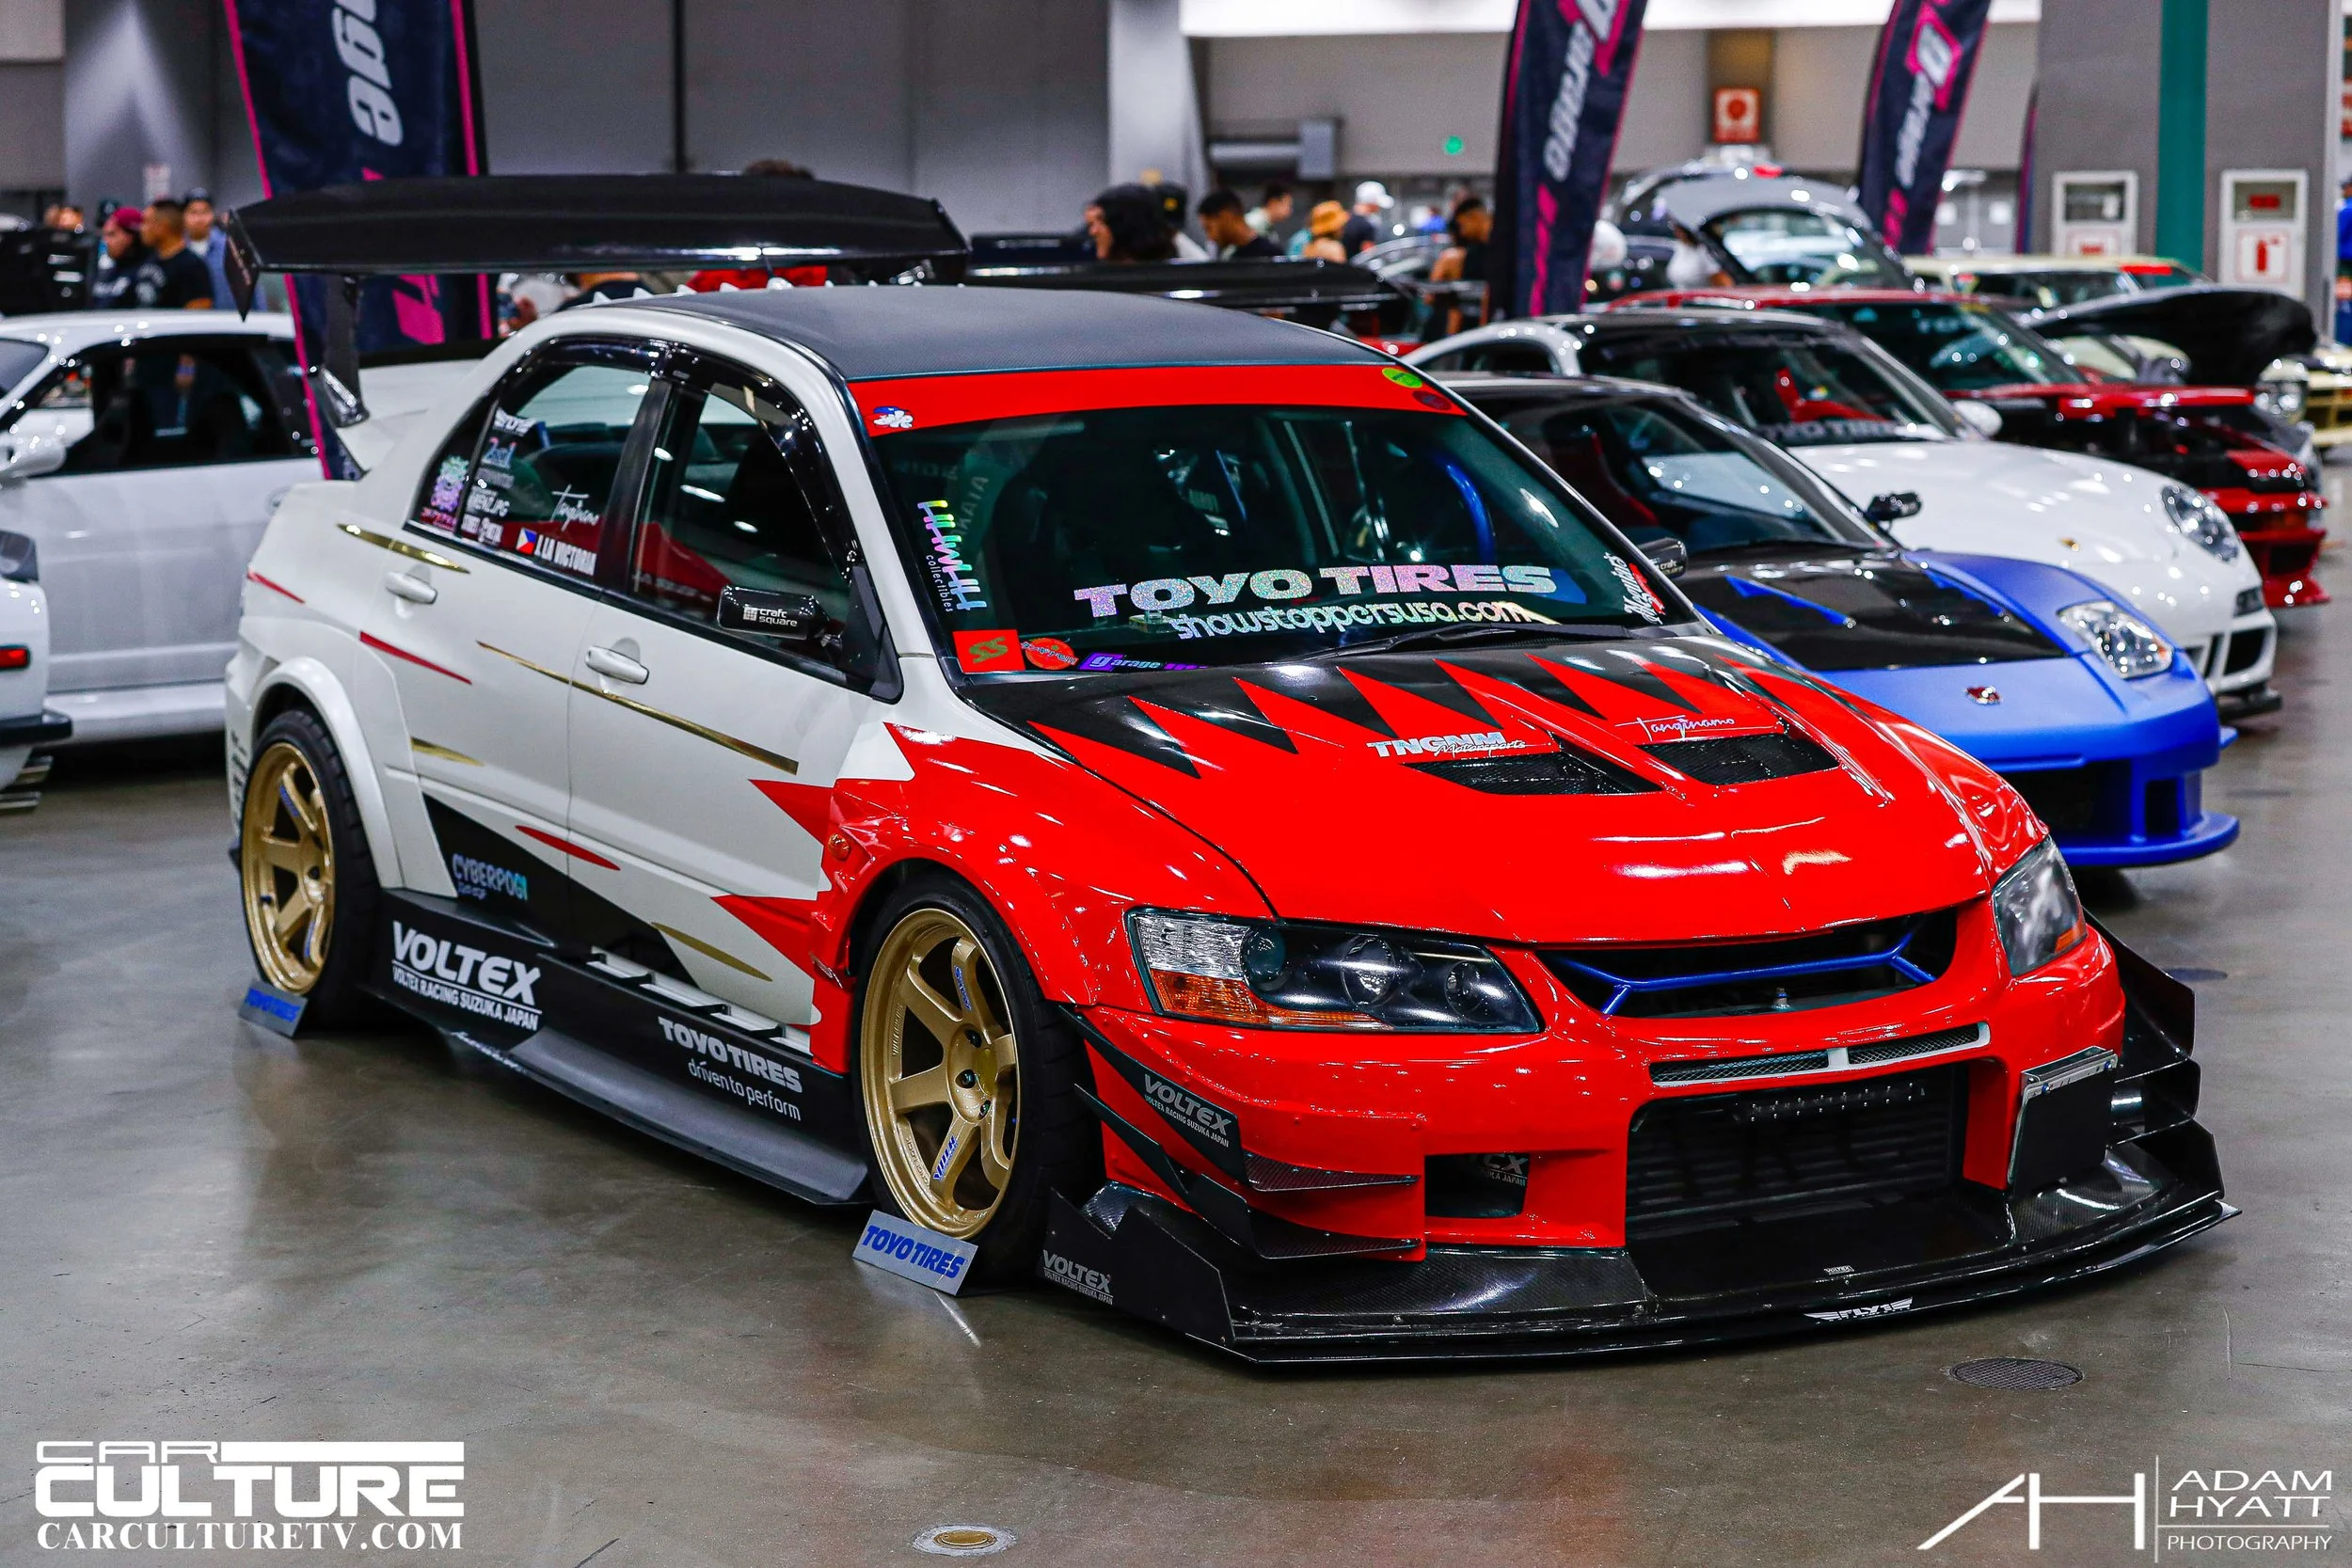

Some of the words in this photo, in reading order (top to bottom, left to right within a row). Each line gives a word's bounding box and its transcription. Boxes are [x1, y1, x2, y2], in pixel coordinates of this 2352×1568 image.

[925, 553, 954, 613] collectibles
[1073, 568, 1313, 618] TOYO
[1319, 564, 1558, 595] TIRES
[758, 614, 799, 627] square
[759, 608, 787, 619] craft
[1168, 600, 1536, 641] showstoppersusa.com
[1366, 731, 1507, 758] TNGNM
[452, 852, 529, 901] CYBERPOGI
[392, 920, 542, 1006] VOLTEX
[392, 966, 418, 995] VOLTEX
[420, 978, 459, 1006] RACING
[459, 990, 502, 1021] SUZUKA
[503, 1008, 539, 1032] JAPAN
[659, 1016, 728, 1064] TOYO
[726, 1043, 803, 1093] TIRES
[688, 1058, 730, 1091] driven
[728, 1075, 745, 1097] to
[747, 1086, 802, 1121] perform
[1144, 1073, 1232, 1136] VOLTEX
[1144, 1094, 1165, 1113] VOLTEX
[1165, 1107, 1186, 1124] RACING
[1186, 1118, 1210, 1138] SUZUKA
[1210, 1132, 1230, 1148] JAPAN
[862, 1225, 915, 1260] TOYO
[910, 1242, 966, 1279] TIRES
[1043, 1249, 1111, 1293] VOLTEX
